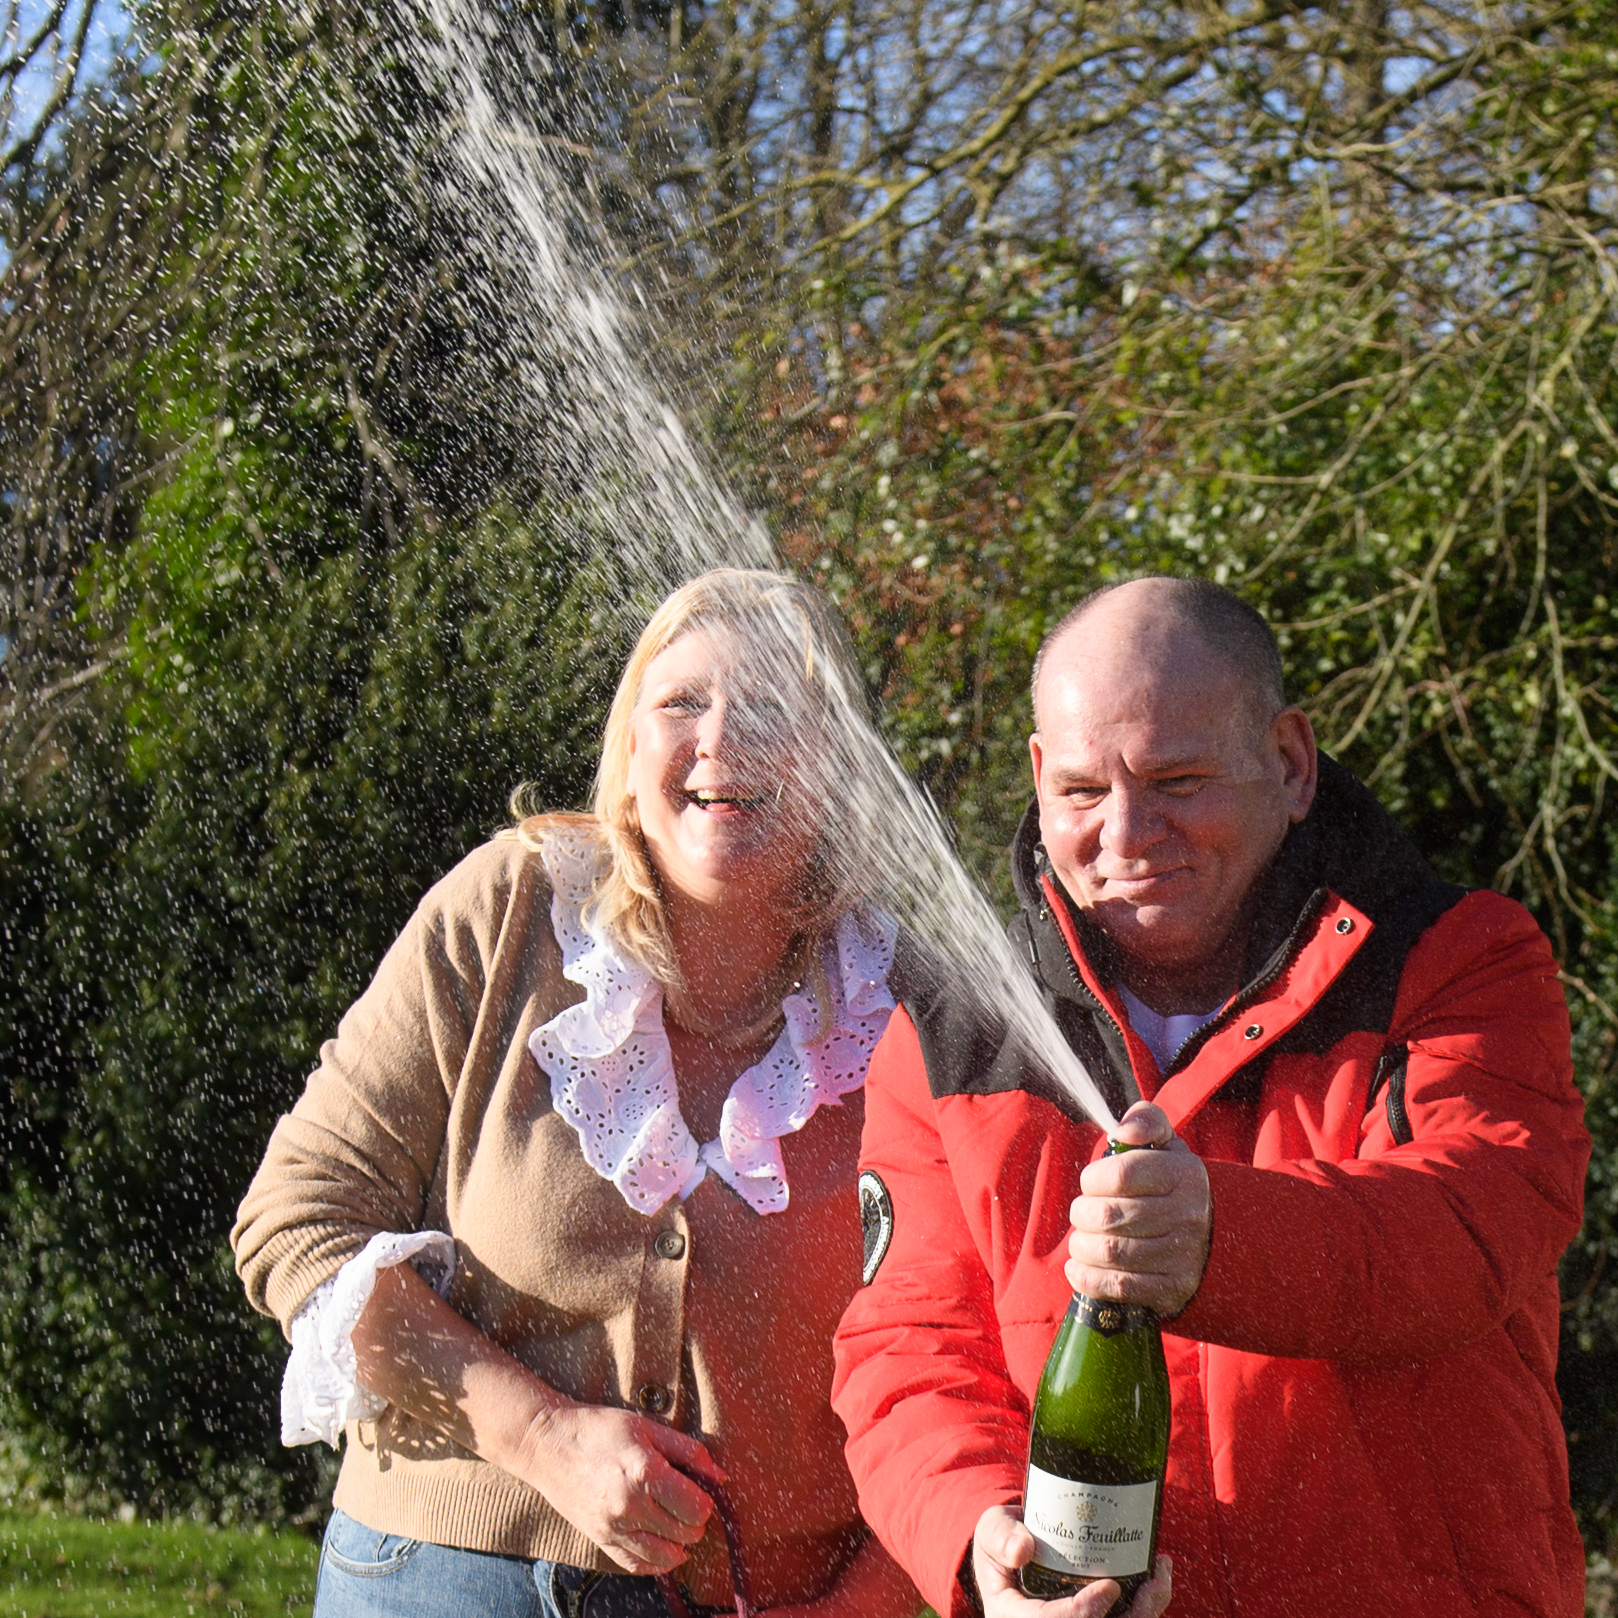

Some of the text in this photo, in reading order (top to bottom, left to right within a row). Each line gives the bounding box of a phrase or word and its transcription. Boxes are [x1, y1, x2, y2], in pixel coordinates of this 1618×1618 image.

[1057, 1492, 1119, 1508] CHAMPAGNE
[1033, 1512, 1144, 1544] Nicolas Feuillatte
